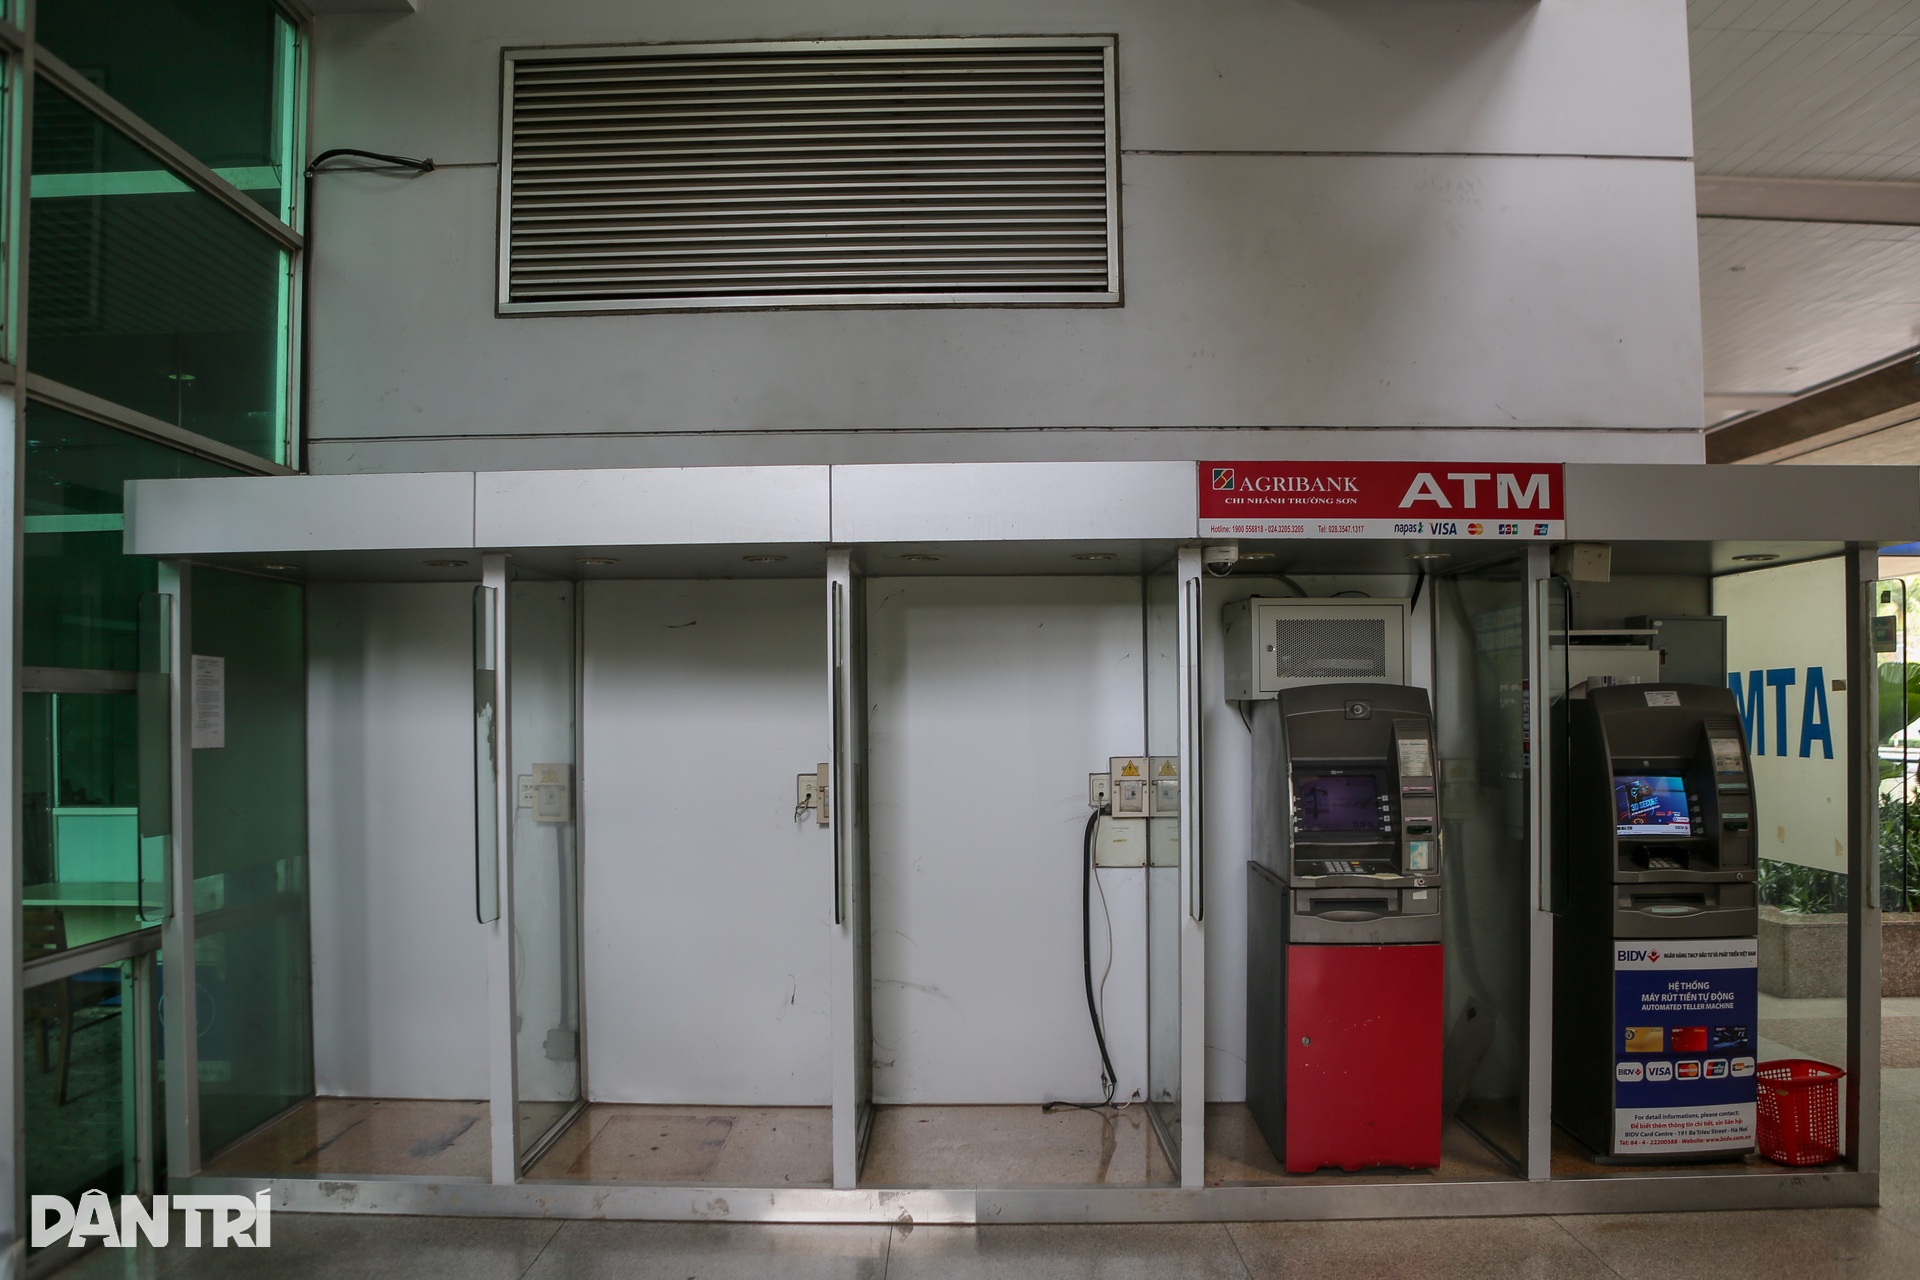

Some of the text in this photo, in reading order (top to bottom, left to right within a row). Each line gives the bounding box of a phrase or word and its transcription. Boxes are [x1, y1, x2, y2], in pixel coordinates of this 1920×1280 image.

[1239, 477, 1360, 492] AGRIBANK
[1398, 472, 1550, 509] ATM
[1248, 496, 1285, 504] NHÁNH
[1288, 496, 1334, 504] TRƯỜNG
[1210, 525, 1230, 533] Hotline:
[1394, 524, 1417, 536] napas
[1429, 522, 1457, 535] VISA
[1618, 950, 1647, 961] BIDV
[1668, 980, 1710, 992] HỆ THỐNG
[1642, 992, 1660, 1002] MÁY
[1662, 992, 1678, 1002] RÚT
[1698, 992, 1710, 1002] TỰ
[1710, 991, 1734, 1002] ĐỘNG
[1648, 1067, 1671, 1076] VISA
